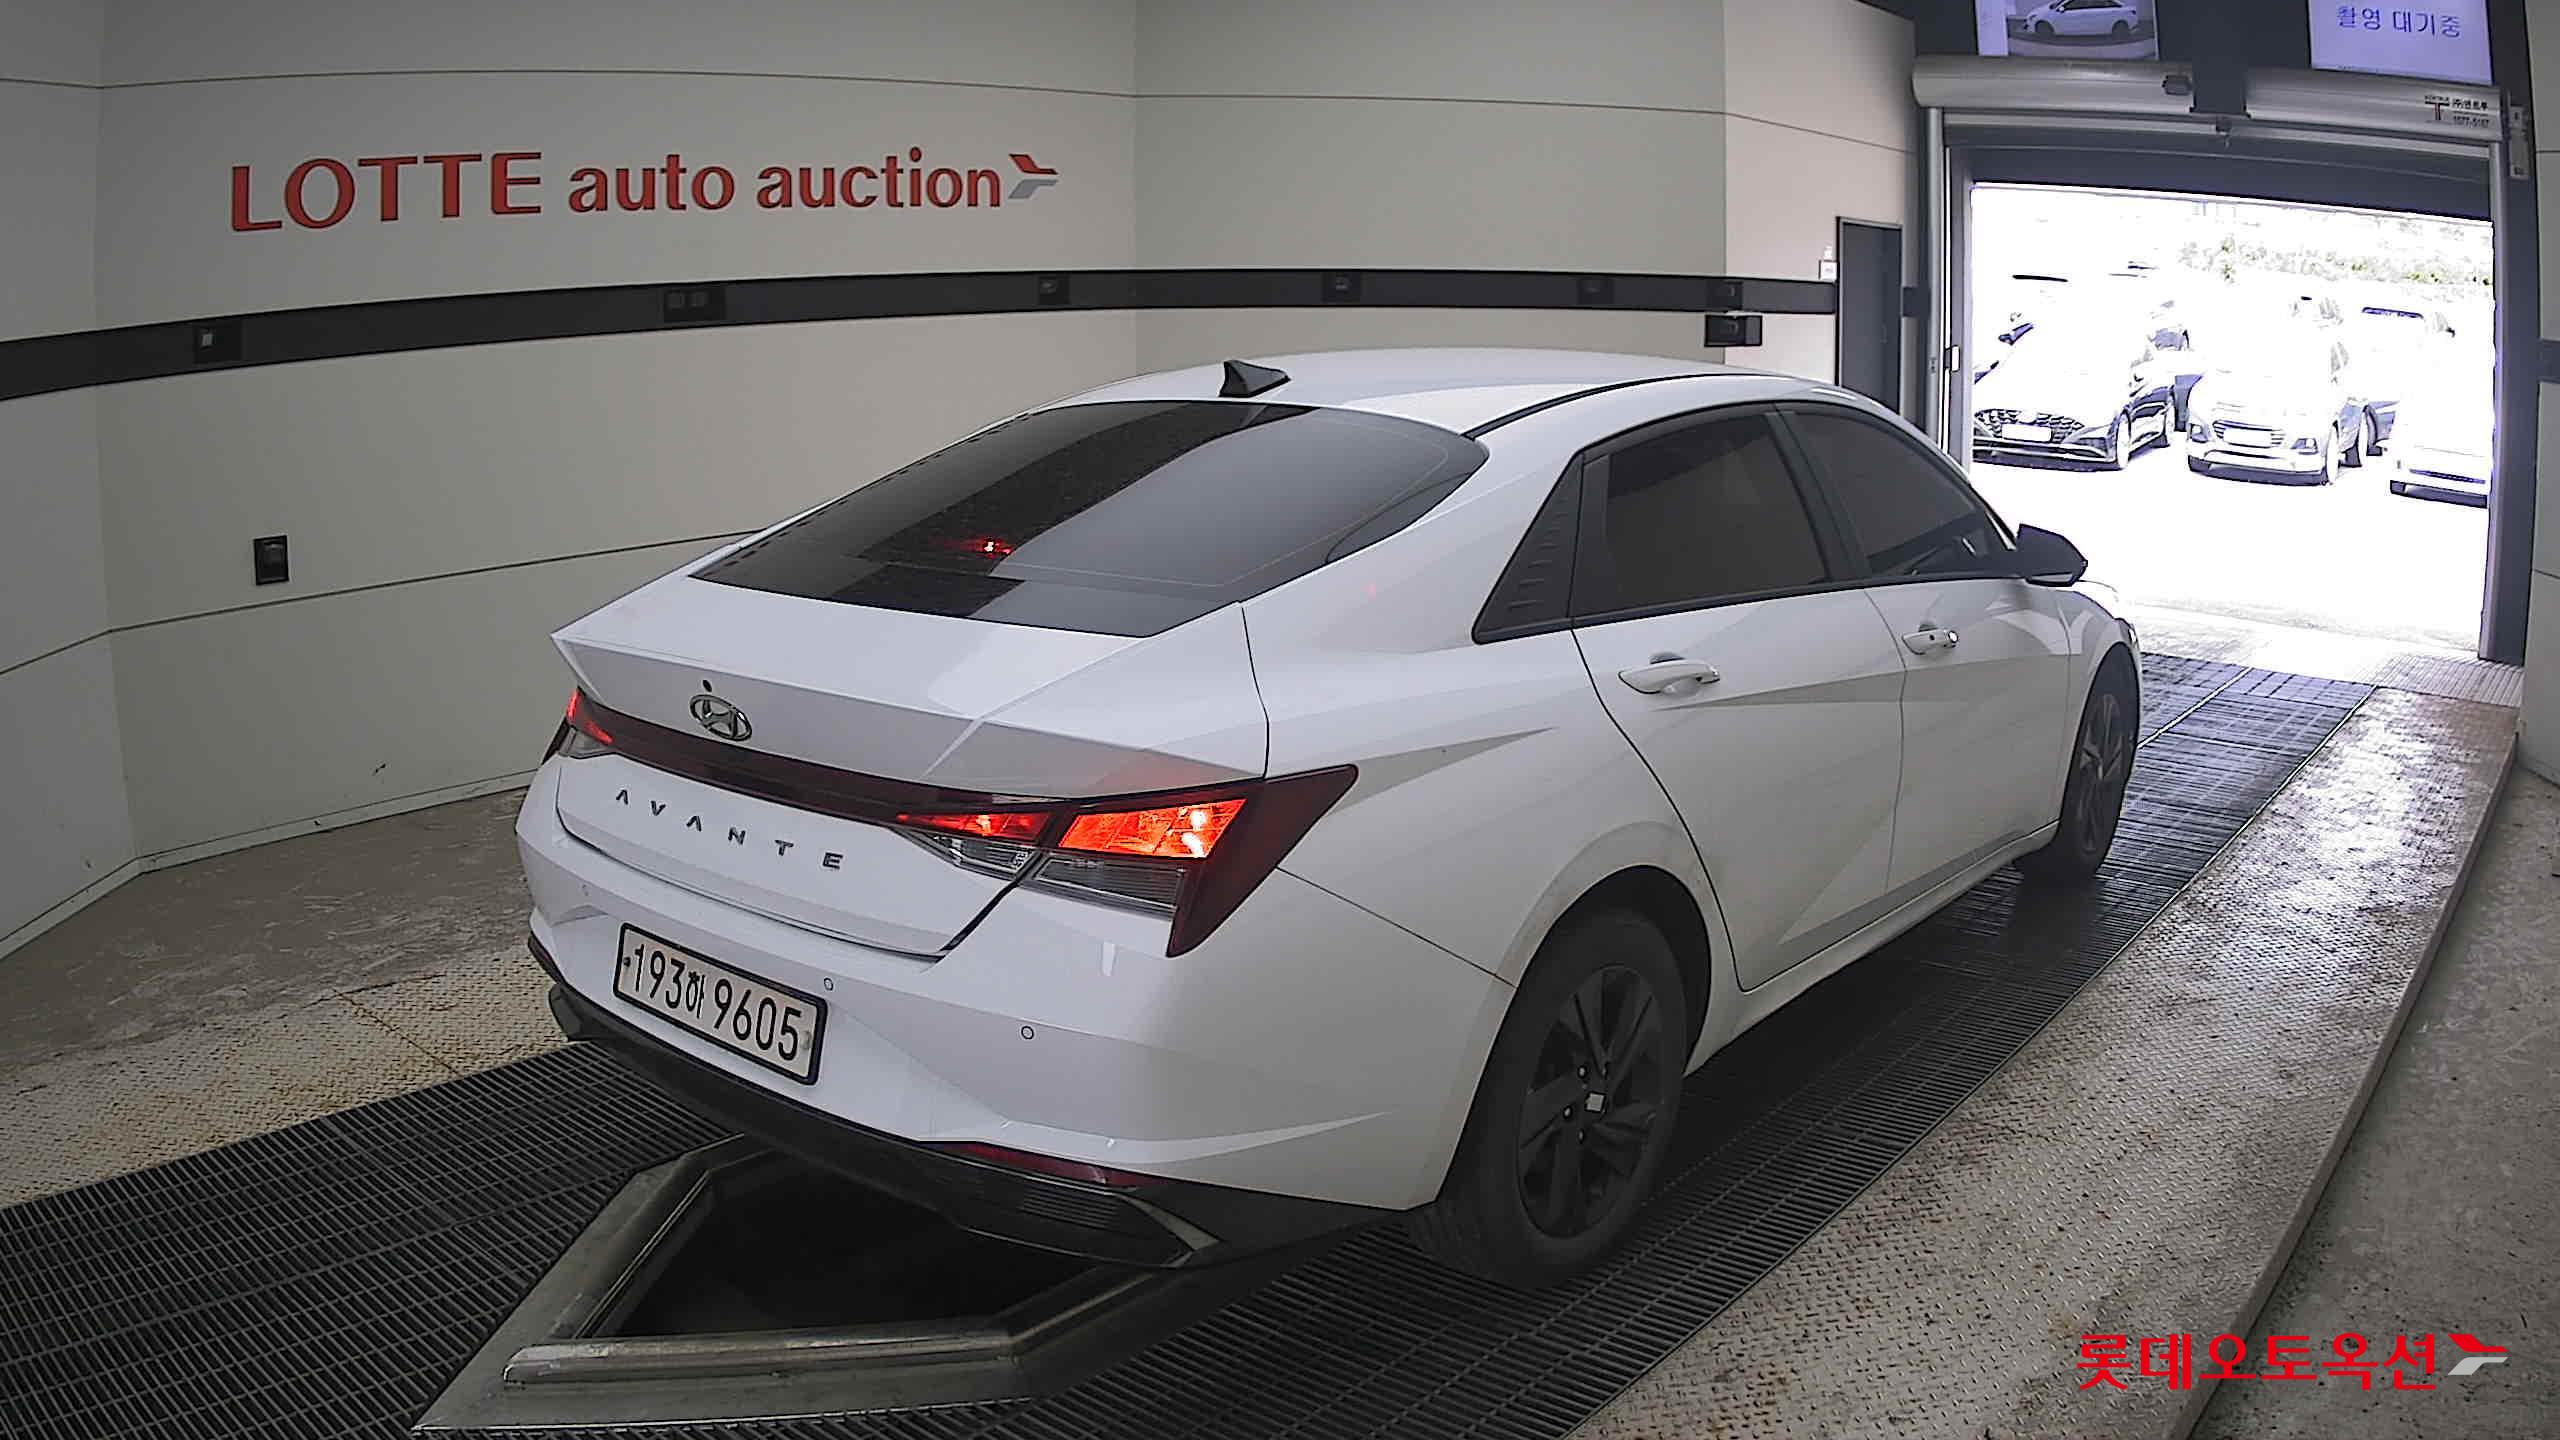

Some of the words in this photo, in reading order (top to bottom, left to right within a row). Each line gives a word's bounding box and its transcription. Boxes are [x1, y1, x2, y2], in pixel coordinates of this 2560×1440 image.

[2337, 5, 2381, 31] 촬영
[231, 152, 542, 232] LOTTE
[567, 153, 736, 213] auto
[756, 146, 1001, 208] auction
[615, 789, 844, 870] AVANTE
[713, 978, 803, 1061] 9605
